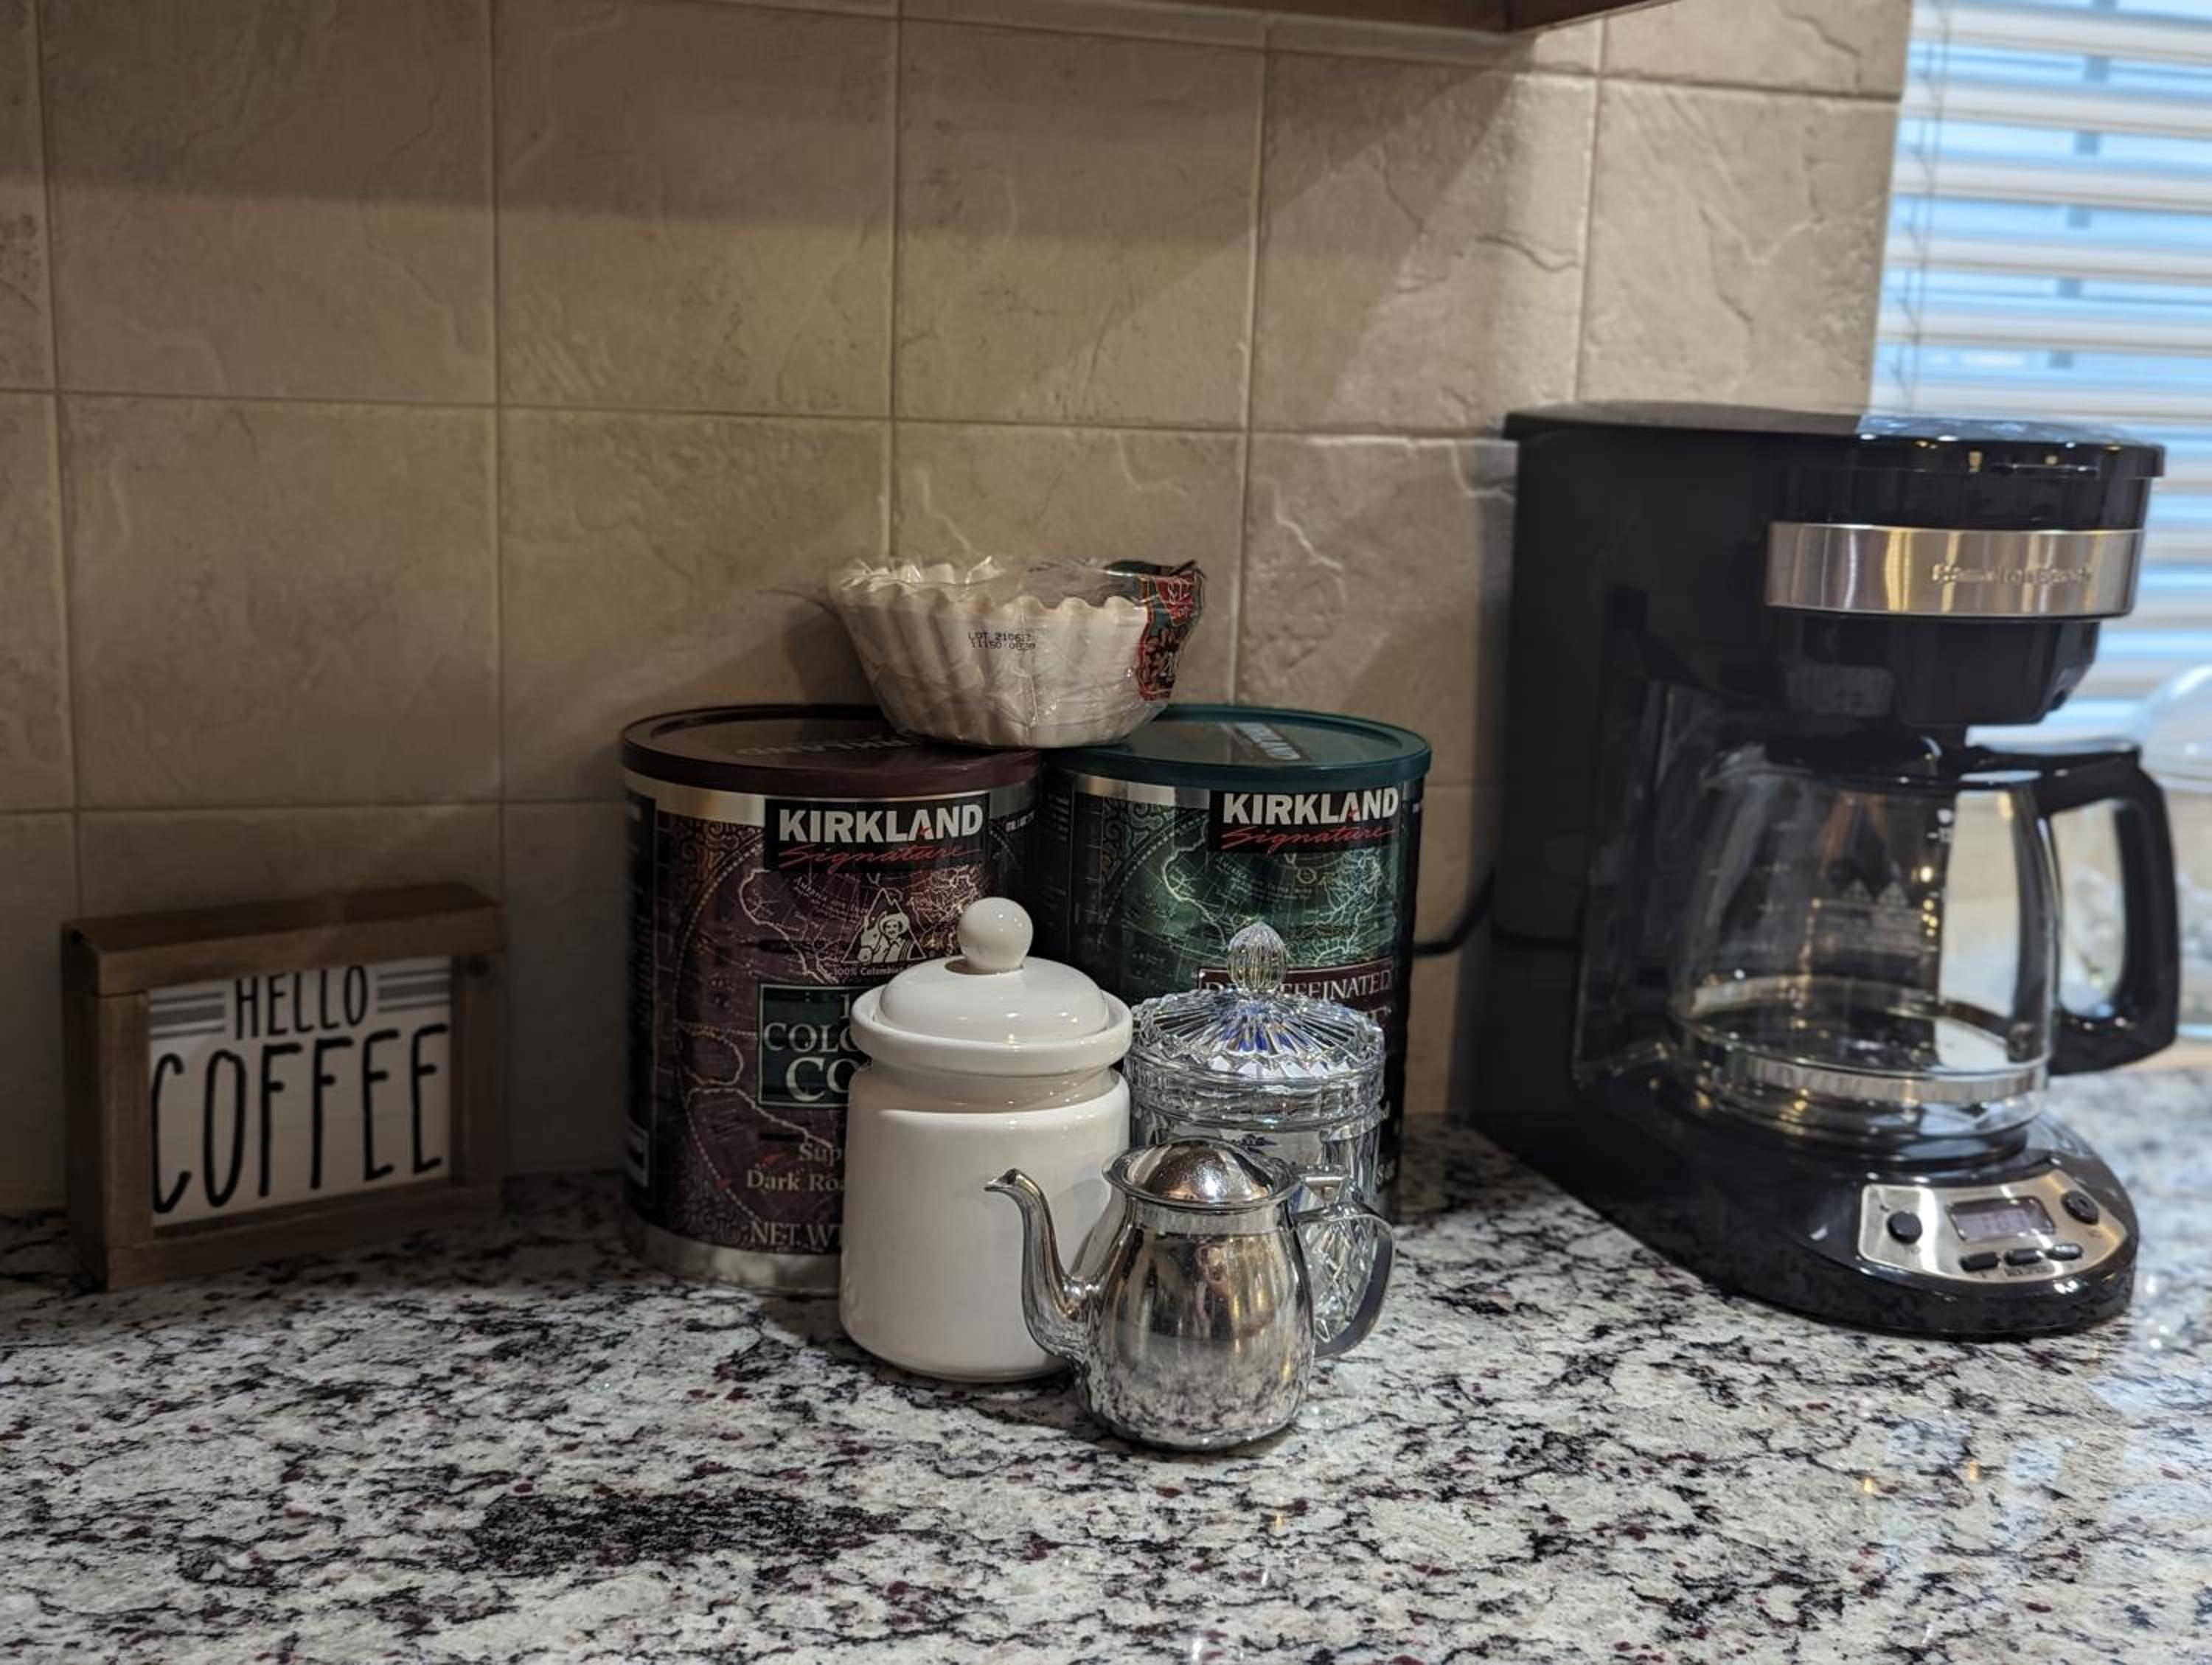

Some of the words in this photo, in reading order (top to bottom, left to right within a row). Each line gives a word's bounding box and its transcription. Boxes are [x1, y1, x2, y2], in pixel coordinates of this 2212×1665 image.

[1222, 787, 1399, 825] KIRKLAND
[778, 804, 984, 843] KIRKLAND
[1220, 825, 1397, 855] Signature
[778, 843, 984, 874] Signature
[834, 966, 858, 977] 100%
[234, 964, 369, 1040] HELLO
[151, 1023, 449, 1214] COFFEE
[746, 1169, 801, 1192] Dark
